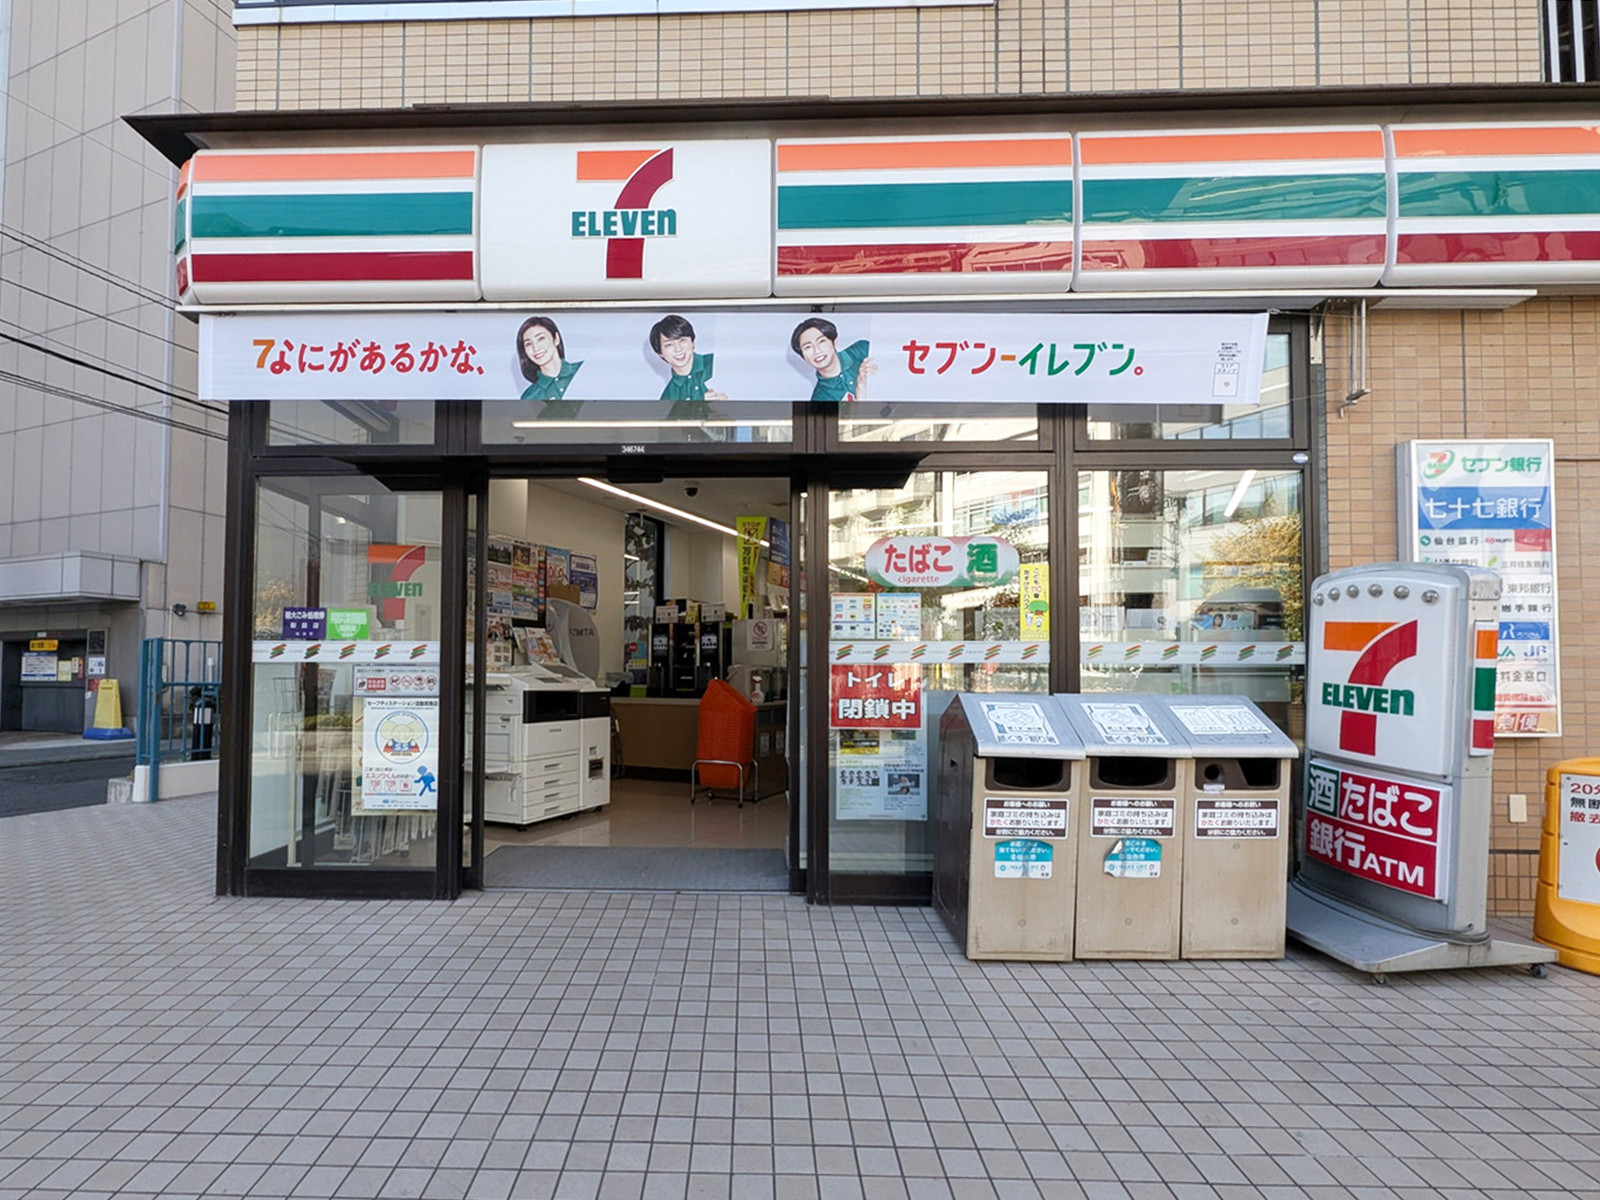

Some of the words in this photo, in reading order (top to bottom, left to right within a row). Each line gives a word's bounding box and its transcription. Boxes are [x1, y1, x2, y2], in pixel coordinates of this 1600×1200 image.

[571, 209, 677, 237] ELEVEN
[577, 147, 674, 279] 7
[1461, 456, 1542, 473] セブン銀行
[1424, 497, 1542, 519] 七十七銀行
[884, 543, 954, 573] たばこ
[966, 543, 998, 573] 酒
[897, 575, 940, 584] cigarette
[1507, 582, 1552, 594] 東邦銀行
[1322, 682, 1415, 716] ELEVEN
[1324, 619, 1418, 756] 7
[838, 698, 917, 720] 閉鎖中
[1309, 767, 1338, 813] 酒
[1341, 777, 1433, 837] たばこ
